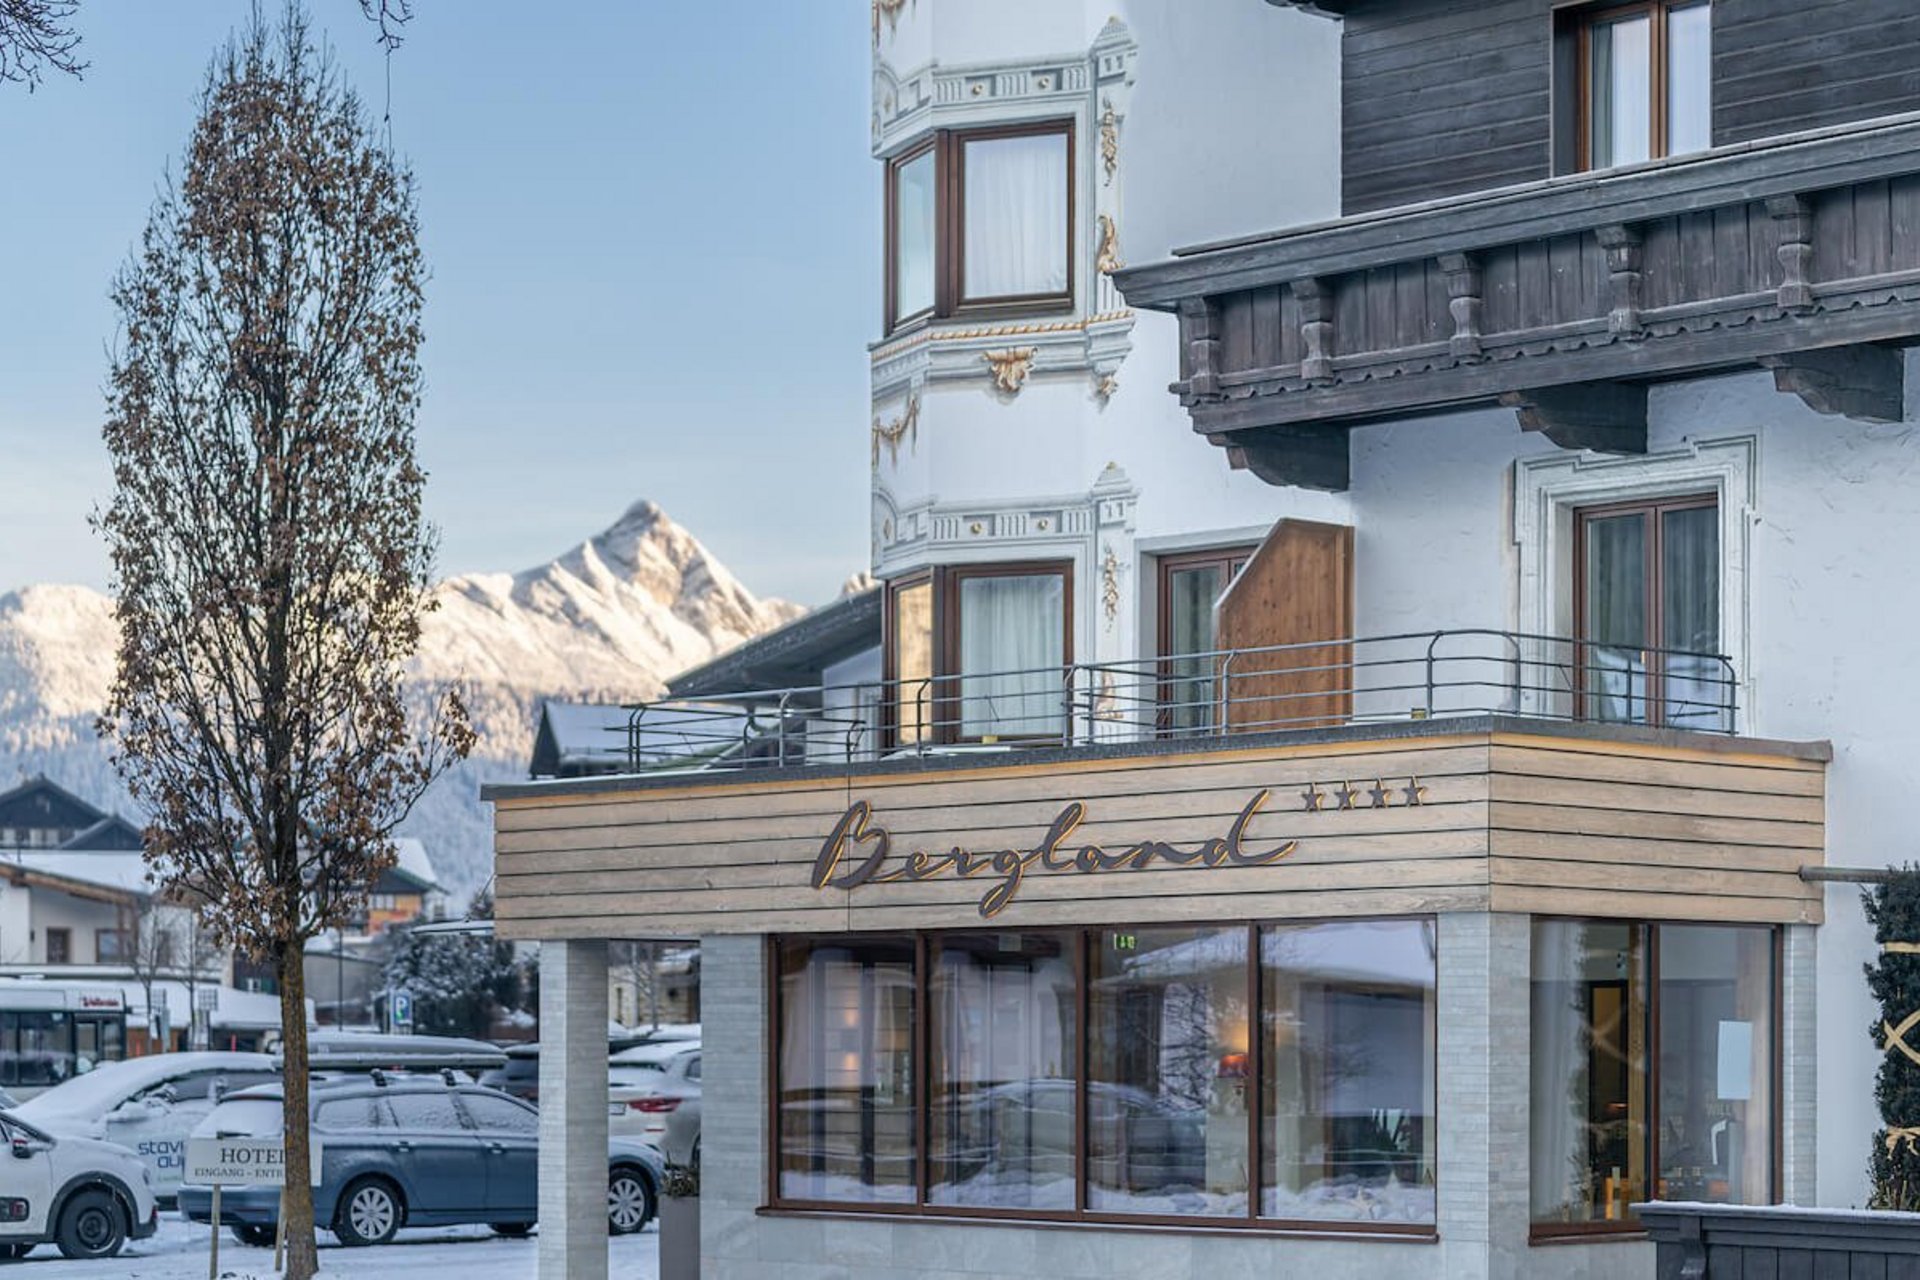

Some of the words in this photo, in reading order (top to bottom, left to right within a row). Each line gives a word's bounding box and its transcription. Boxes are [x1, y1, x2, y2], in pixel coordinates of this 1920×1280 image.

[811, 789, 1298, 918] Bergland
[194, 1168, 244, 1177] EINGANG
[255, 1168, 283, 1178] ENTR
